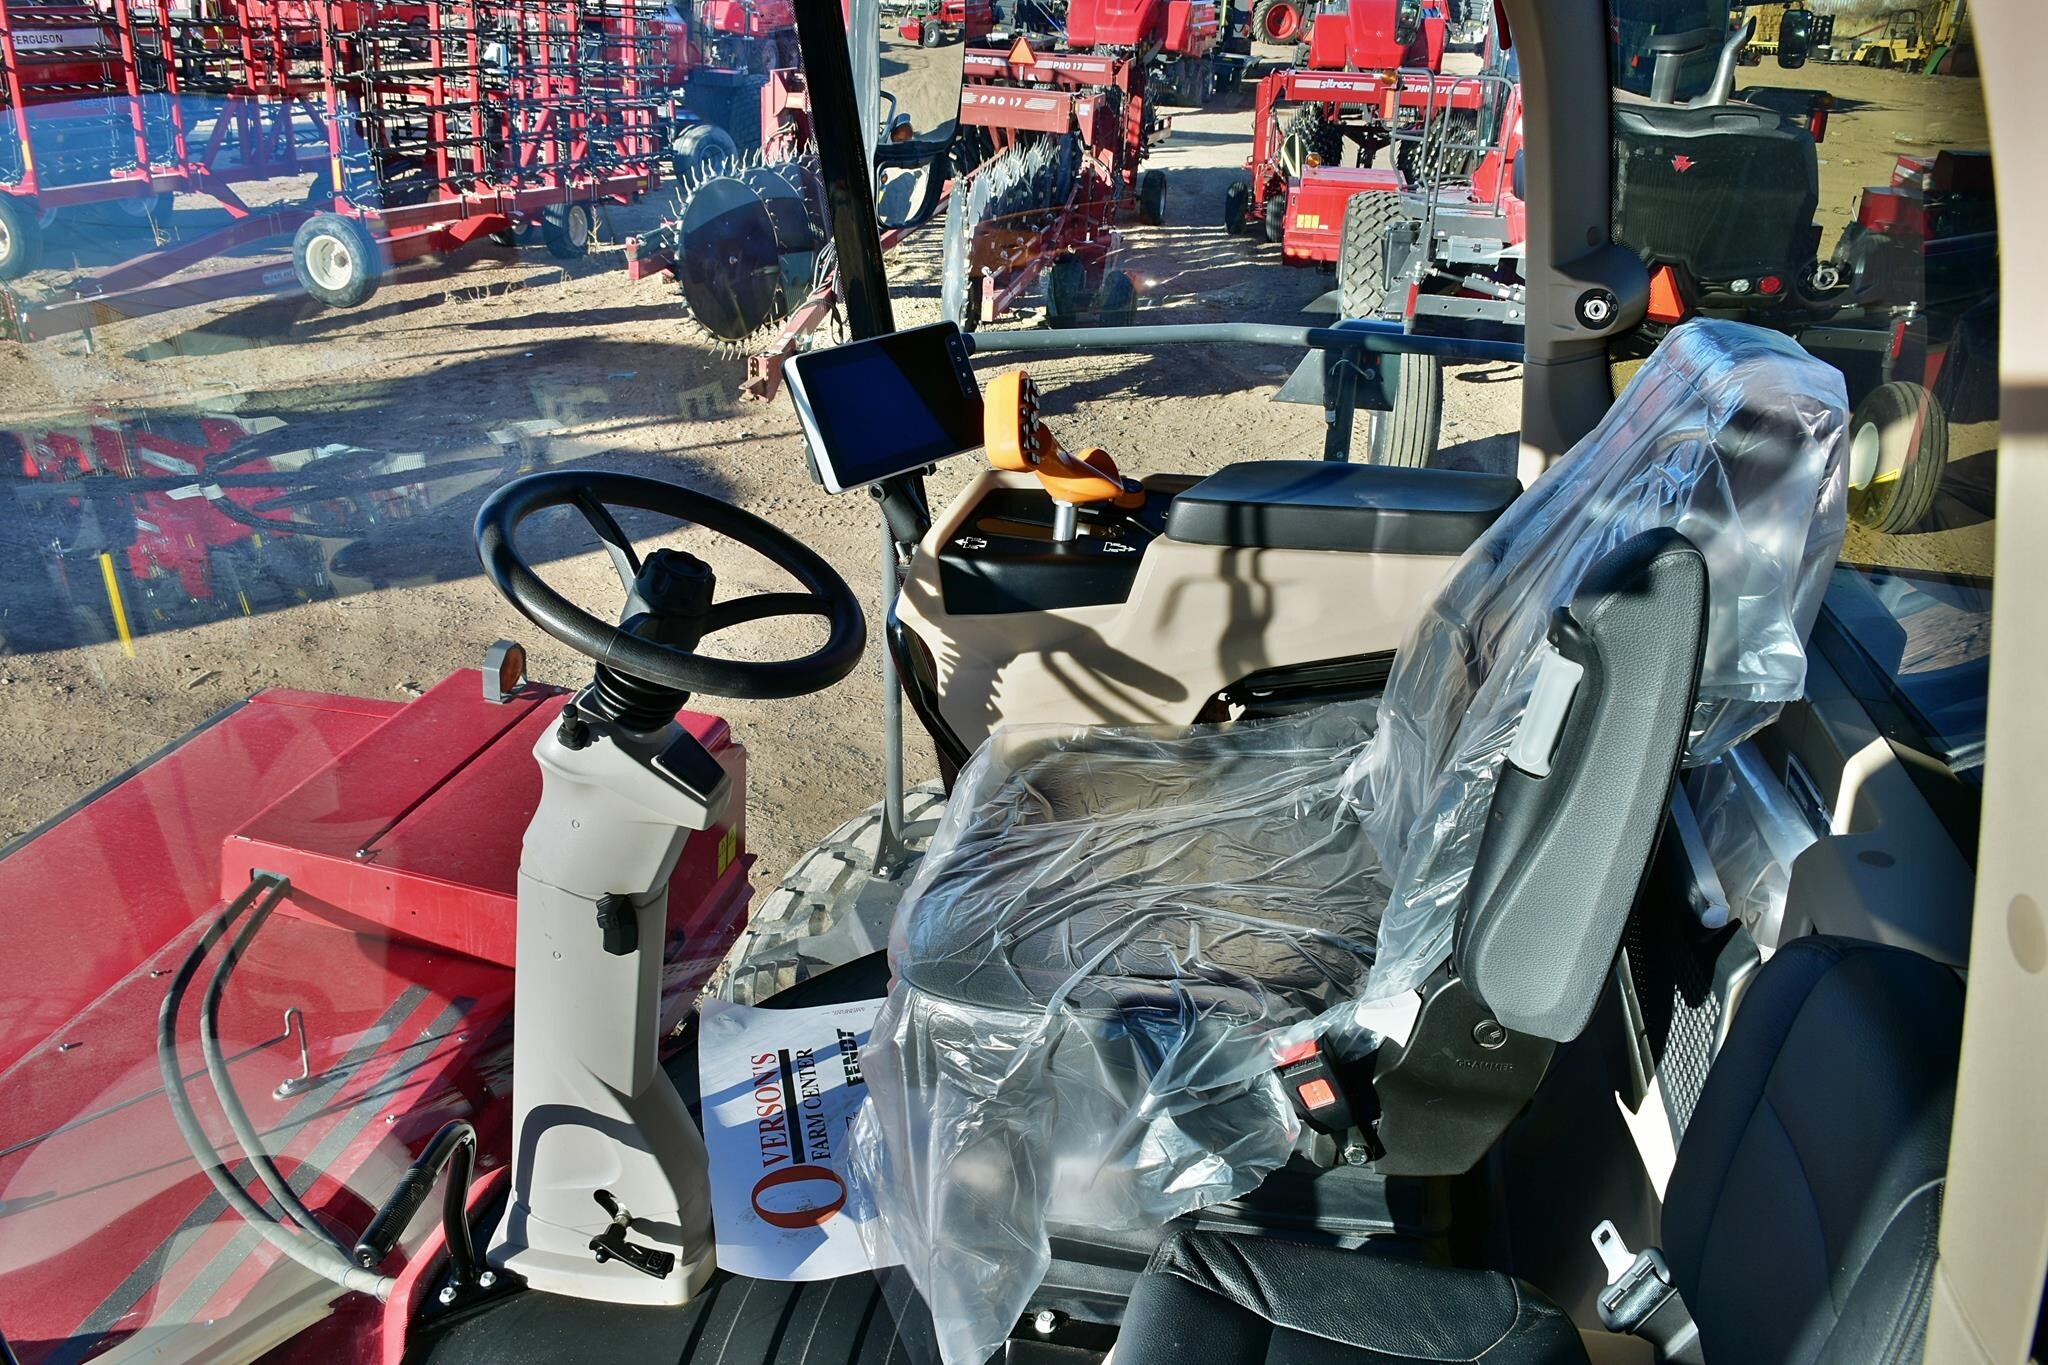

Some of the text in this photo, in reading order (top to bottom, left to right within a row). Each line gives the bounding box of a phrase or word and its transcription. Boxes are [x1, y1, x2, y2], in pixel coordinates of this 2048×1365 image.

[1053, 61, 1071, 70] PRO
[1072, 62, 1083, 71] 17
[1320, 78, 1353, 90] sitrex
[1010, 97, 1022, 107] 17
[836, 1028, 865, 1088] FENDT
[796, 1047, 832, 1162] FARM CENTER
